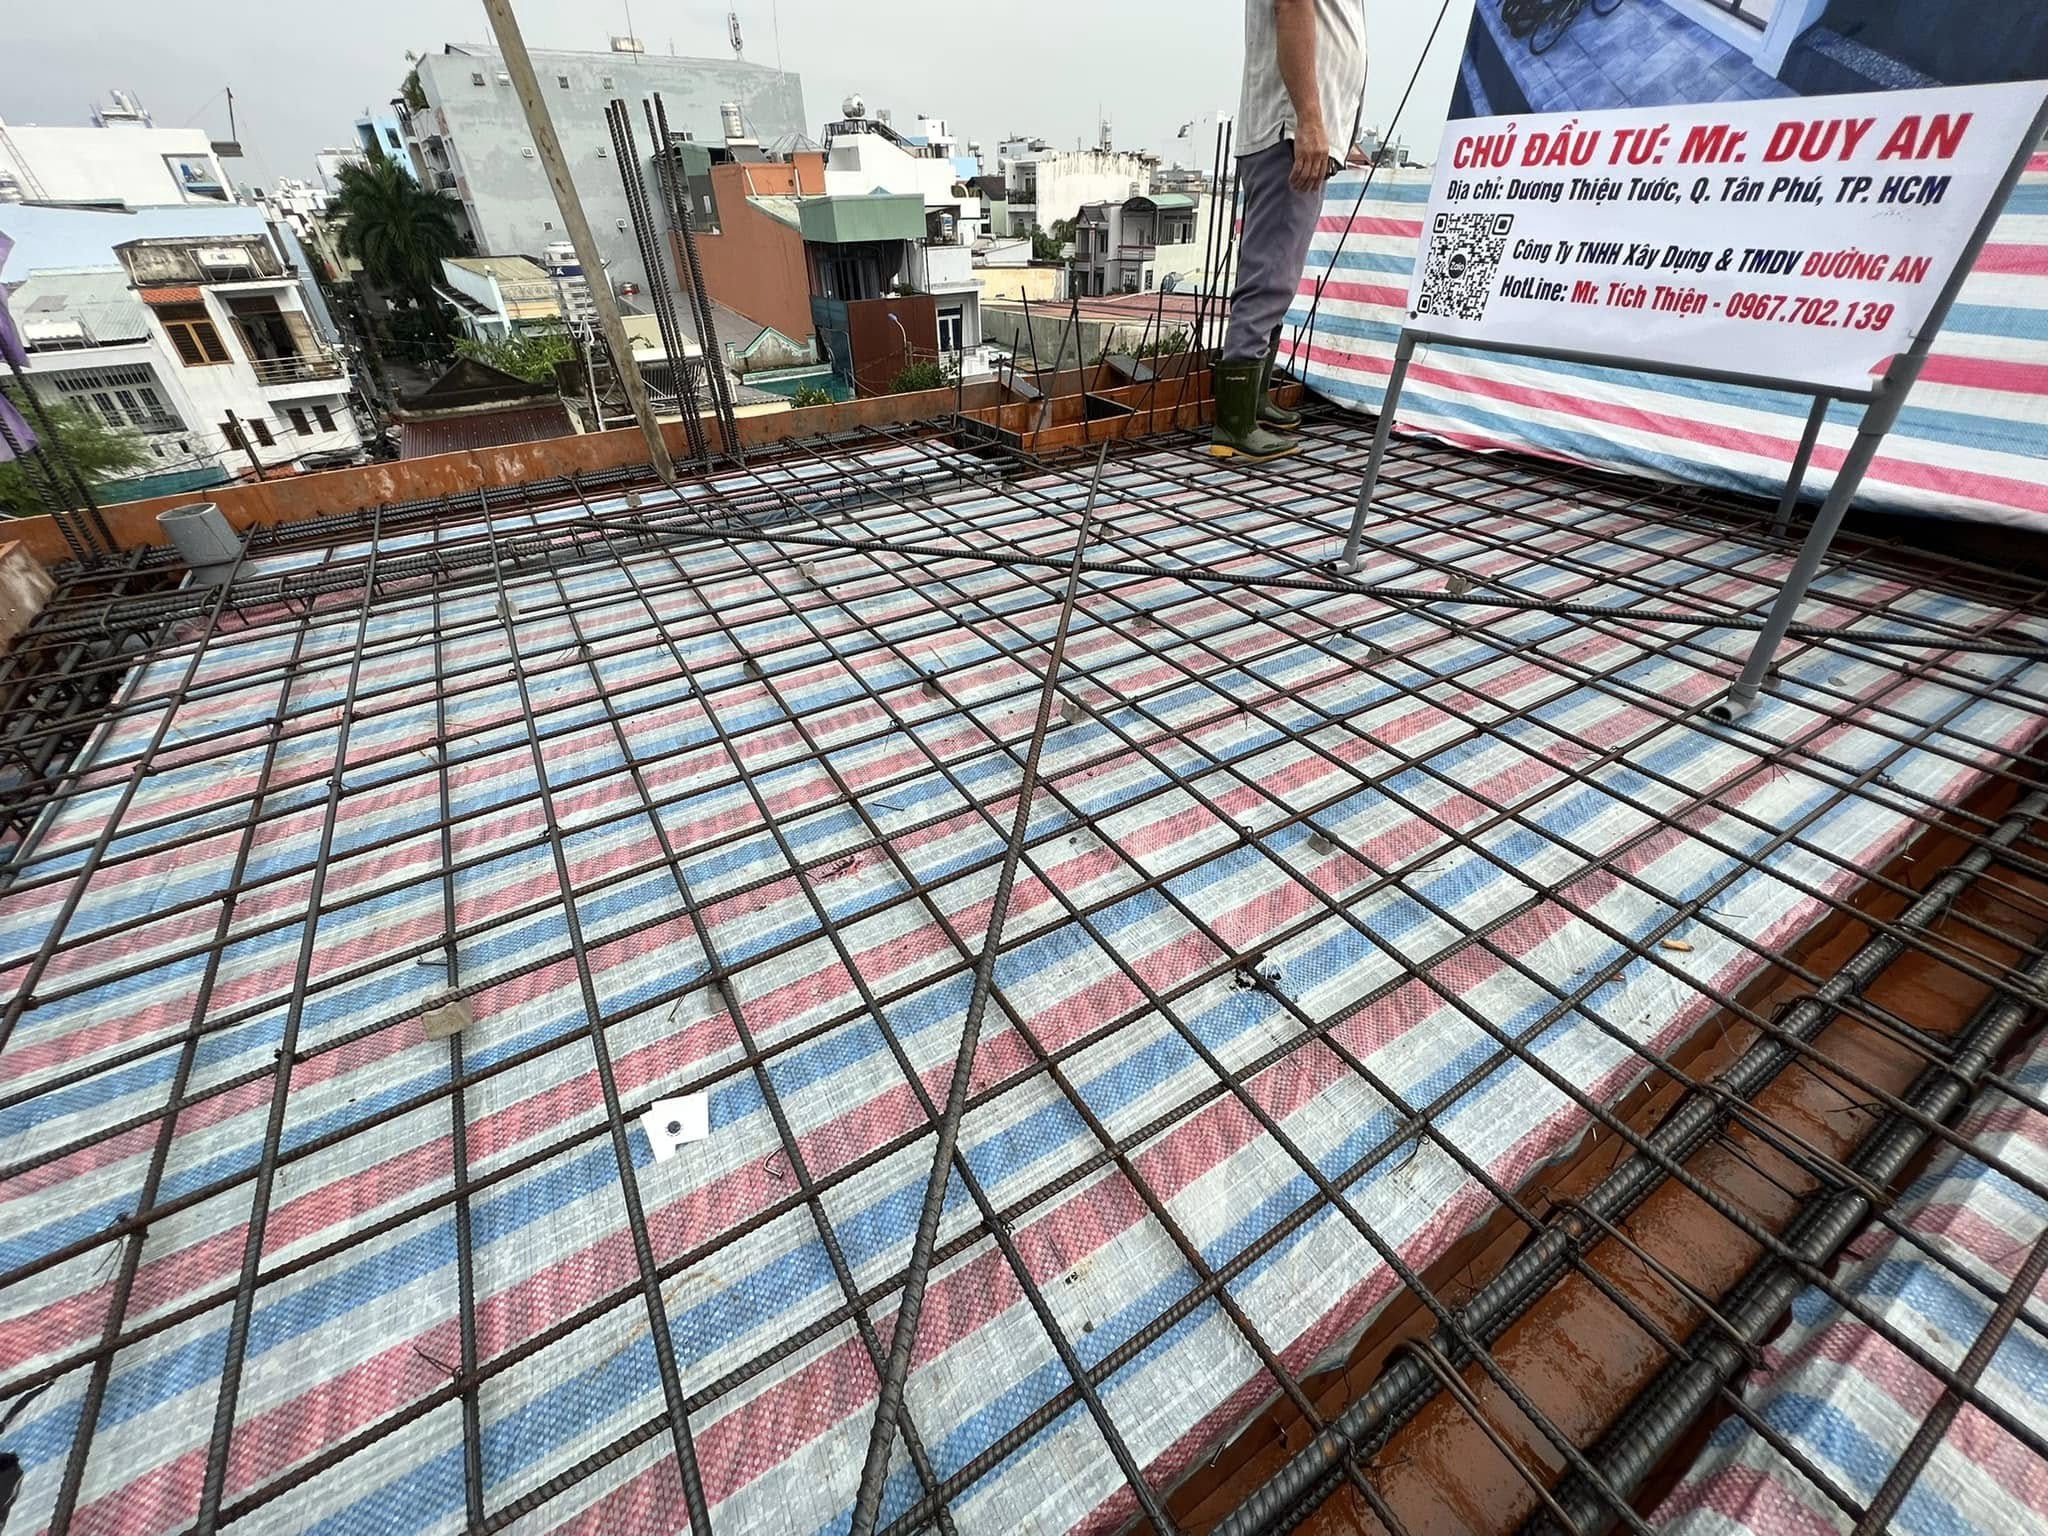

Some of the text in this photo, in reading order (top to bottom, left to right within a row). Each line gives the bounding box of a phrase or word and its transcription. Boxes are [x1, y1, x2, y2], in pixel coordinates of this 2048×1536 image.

[1453, 112, 1974, 169] CHỦ ĐẦU TƯ: Mr. DUY AN
[1446, 174, 1952, 206] Địa chỉ: Dương Thiệu Tước, Q. Tân Phú, TP. HCM
[1512, 239, 1552, 264] Công
[1558, 240, 1573, 265] Ty
[1575, 241, 1624, 265] TNHH
[1622, 243, 1661, 270] Xây
[1660, 245, 1714, 274] Dựng
[1714, 248, 1734, 272] &
[1737, 248, 1804, 275] TMDV
[1888, 255, 1933, 284] AN
[1499, 275, 1568, 302] HotLine:
[1570, 280, 1600, 305] Mr.
[1605, 282, 1647, 309] Tích
[1651, 285, 1708, 318] Thiện
[1725, 291, 1895, 331] 0967.702.139
